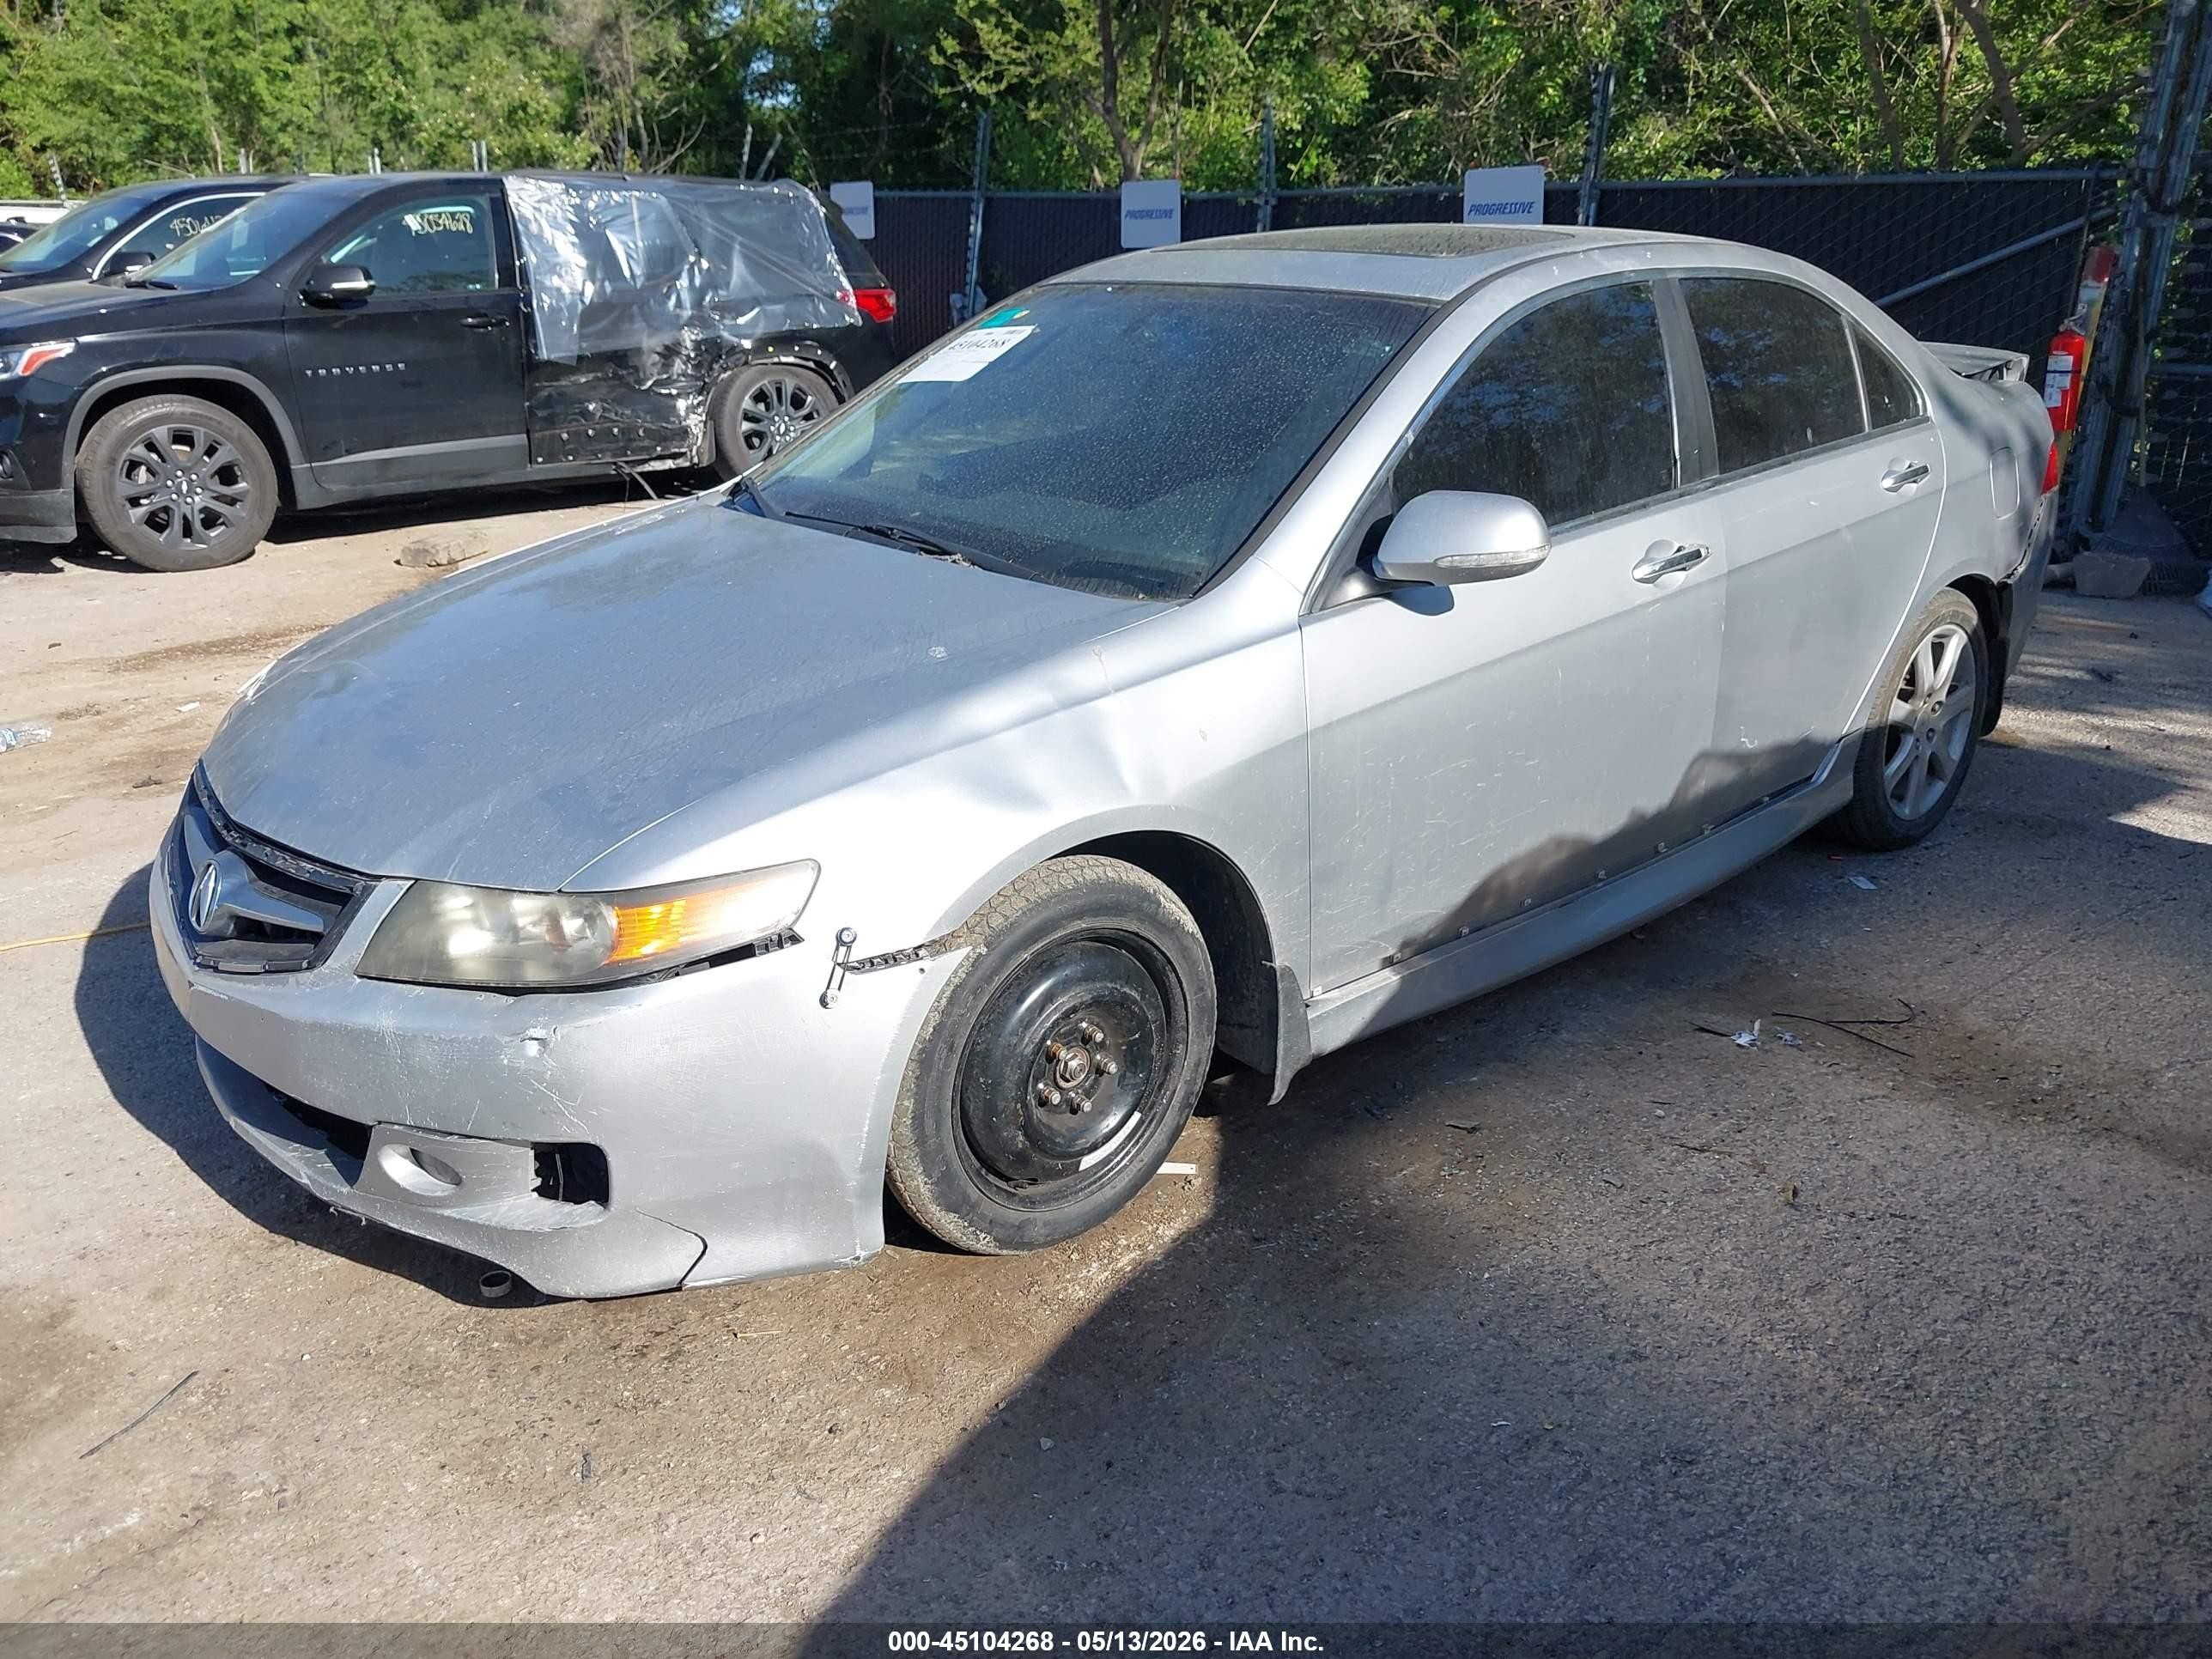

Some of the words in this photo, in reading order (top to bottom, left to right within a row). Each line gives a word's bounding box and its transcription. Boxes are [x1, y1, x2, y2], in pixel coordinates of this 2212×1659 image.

[1124, 209, 1175, 220] PROGRESSIVE
[1468, 200, 1536, 216] PROGRESSIVE
[305, 362, 406, 378] TRAVERSE
